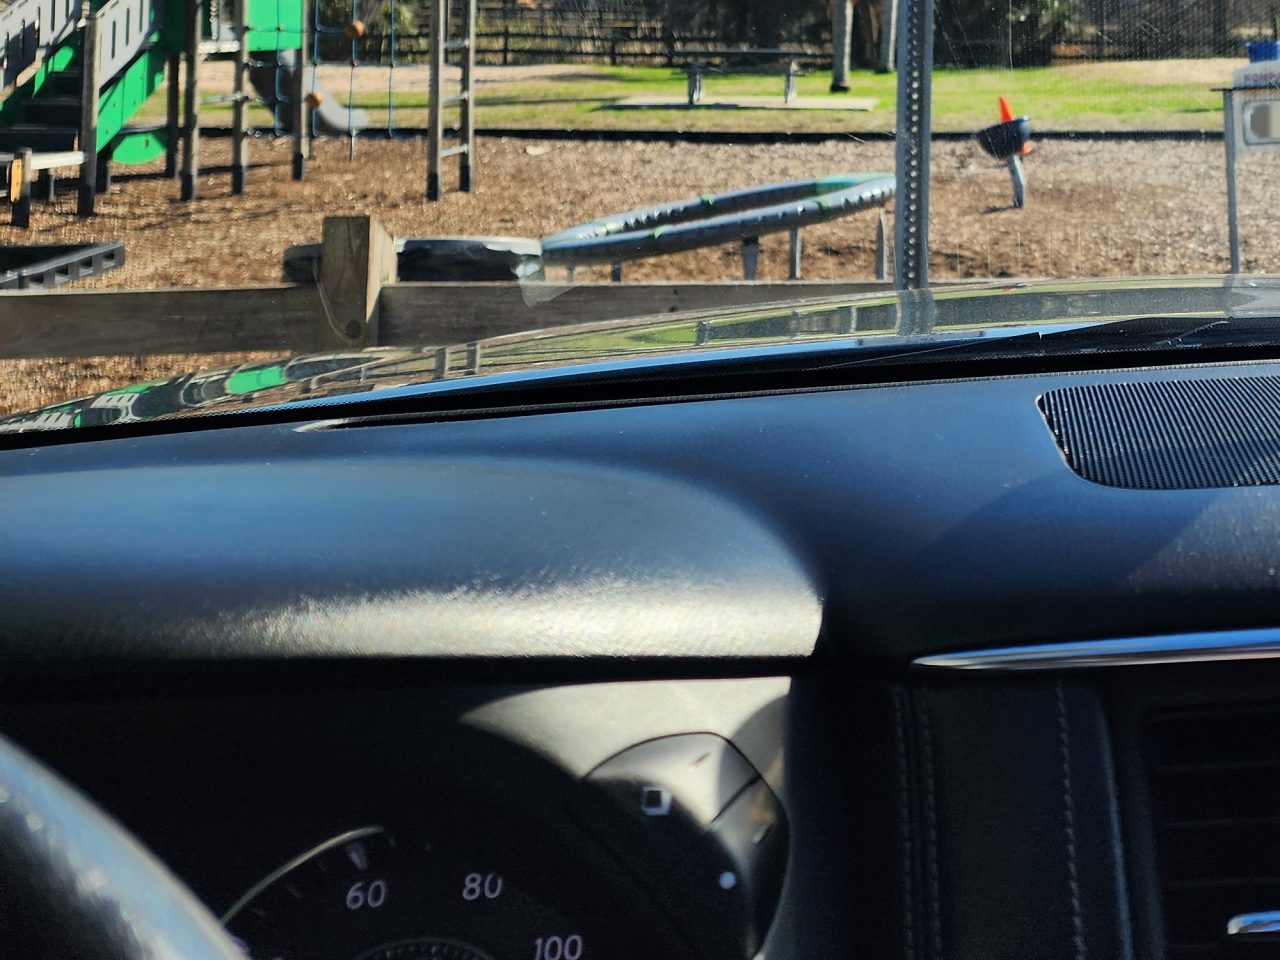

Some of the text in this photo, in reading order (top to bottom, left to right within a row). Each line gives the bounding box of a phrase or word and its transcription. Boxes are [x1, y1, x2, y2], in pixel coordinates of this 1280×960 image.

[346, 879, 387, 910] 60
[462, 872, 503, 901] 80
[534, 934, 584, 960] 100
